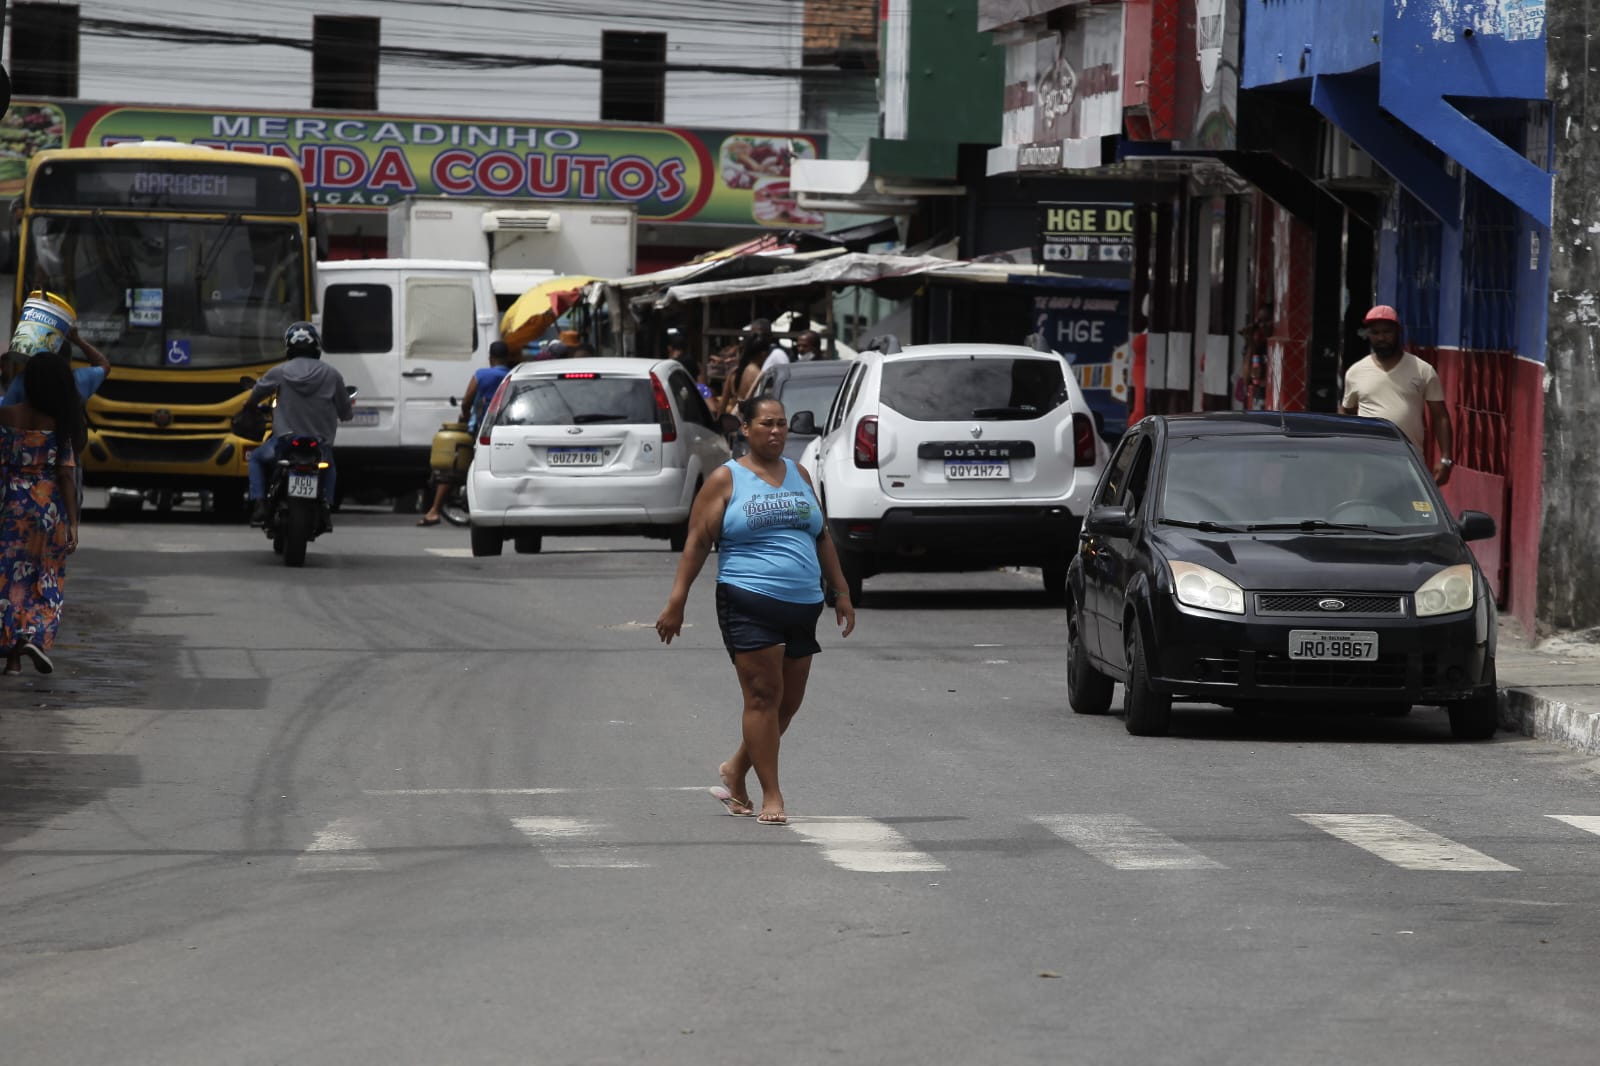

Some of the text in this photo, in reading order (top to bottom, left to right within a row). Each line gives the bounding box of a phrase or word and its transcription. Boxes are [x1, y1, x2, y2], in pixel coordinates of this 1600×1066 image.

[212, 115, 580, 149] MERCADINHO
[134, 172, 228, 195] GARAGEM
[432, 151, 685, 201] COUTOS
[1047, 208, 1097, 231] HGE
[1056, 320, 1106, 343] HGE
[944, 449, 1010, 457] DUSTER
[950, 465, 1003, 477] QQY1H72
